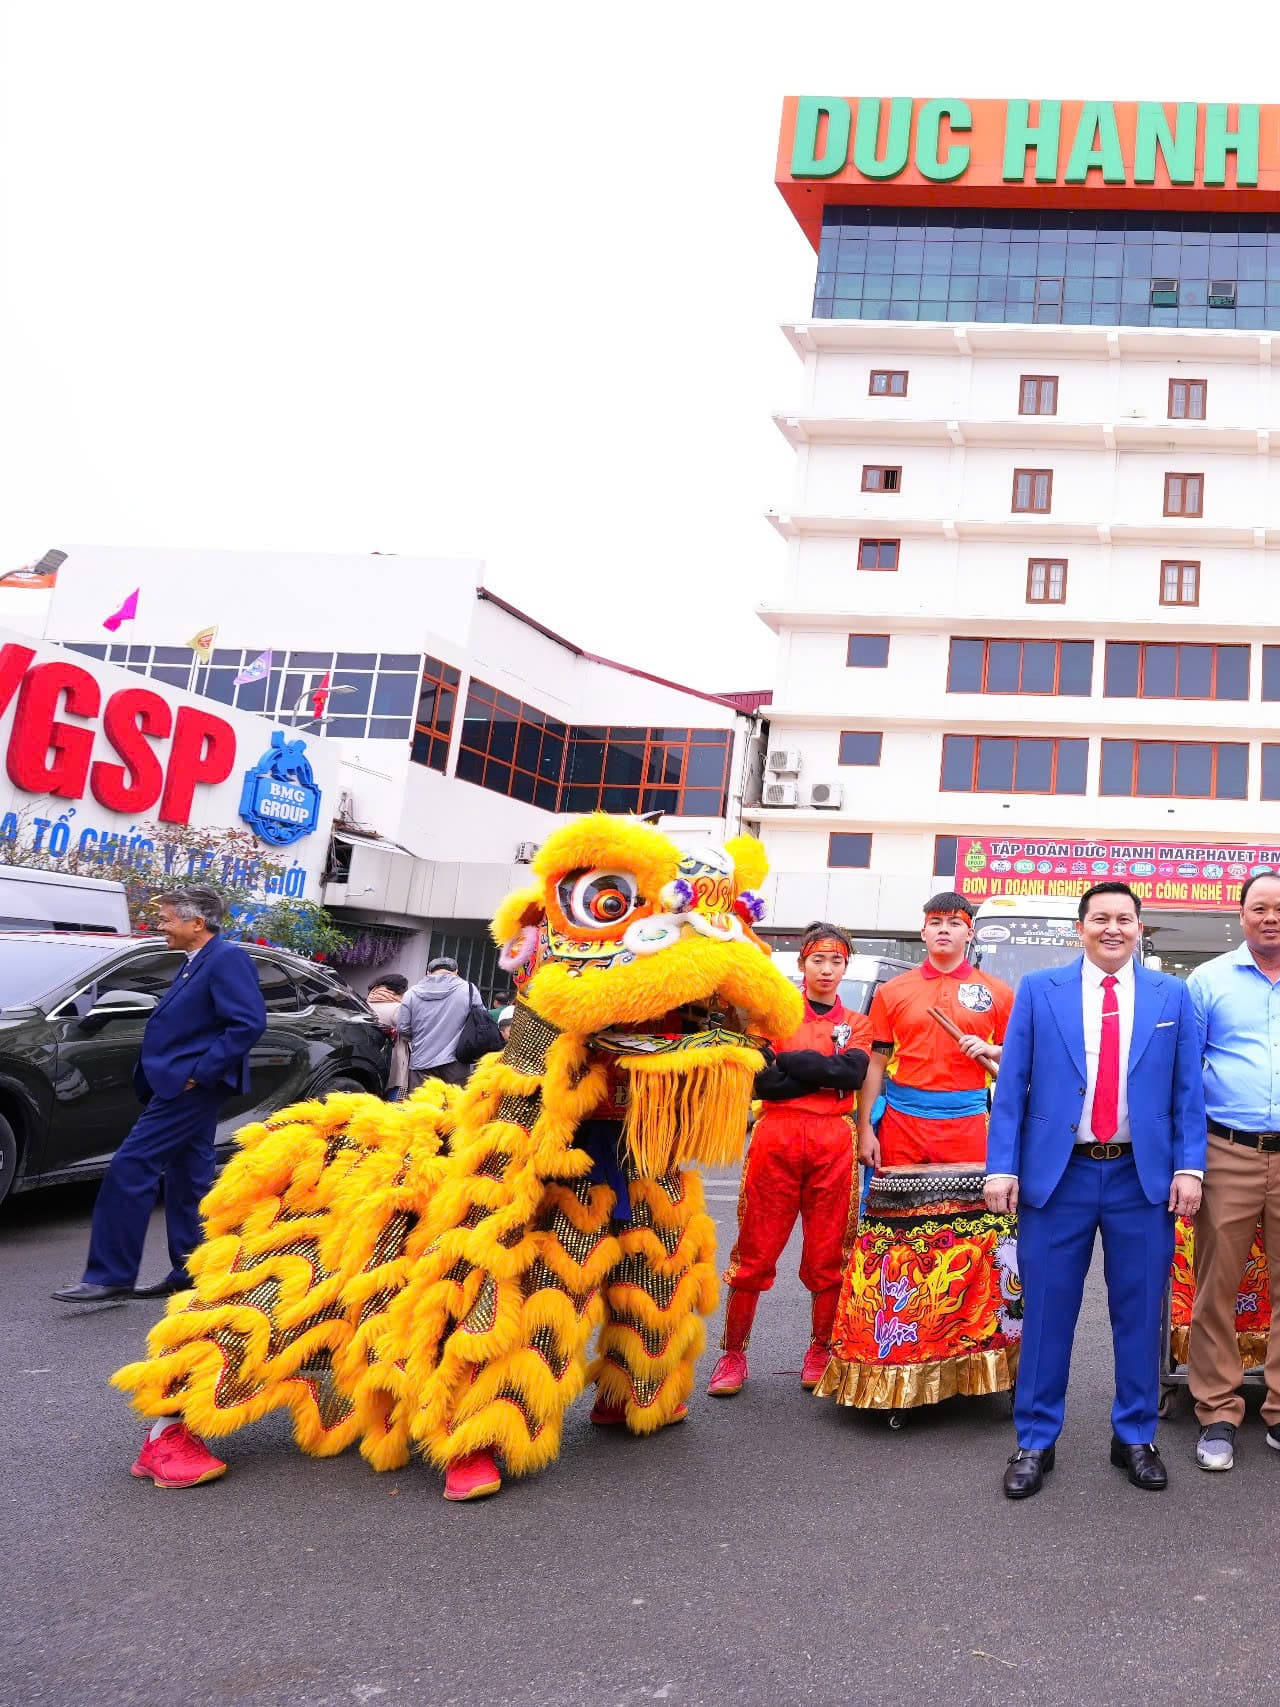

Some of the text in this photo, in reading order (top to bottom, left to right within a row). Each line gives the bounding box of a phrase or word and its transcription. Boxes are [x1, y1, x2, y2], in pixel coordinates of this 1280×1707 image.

[791, 95, 973, 181] DUC
[1001, 99, 1259, 187] HANH
[260, 798, 309, 823] GROUP
[33, 807, 77, 858] TỔ
[991, 840, 1022, 858] TẬP
[1025, 842, 1069, 857] ĐOÀN
[1110, 846, 1155, 861] HẠNH
[1159, 848, 1255, 862] MARPHAVET
[963, 877, 988, 896] ĐƠN
[1005, 879, 1045, 895] DOANH
[1156, 879, 1188, 900] CÔNG
[1191, 880, 1223, 905] NGHỆ
[1010, 936, 1086, 948] ISUZU WEL
[1091, 1144, 1122, 1160] CD
